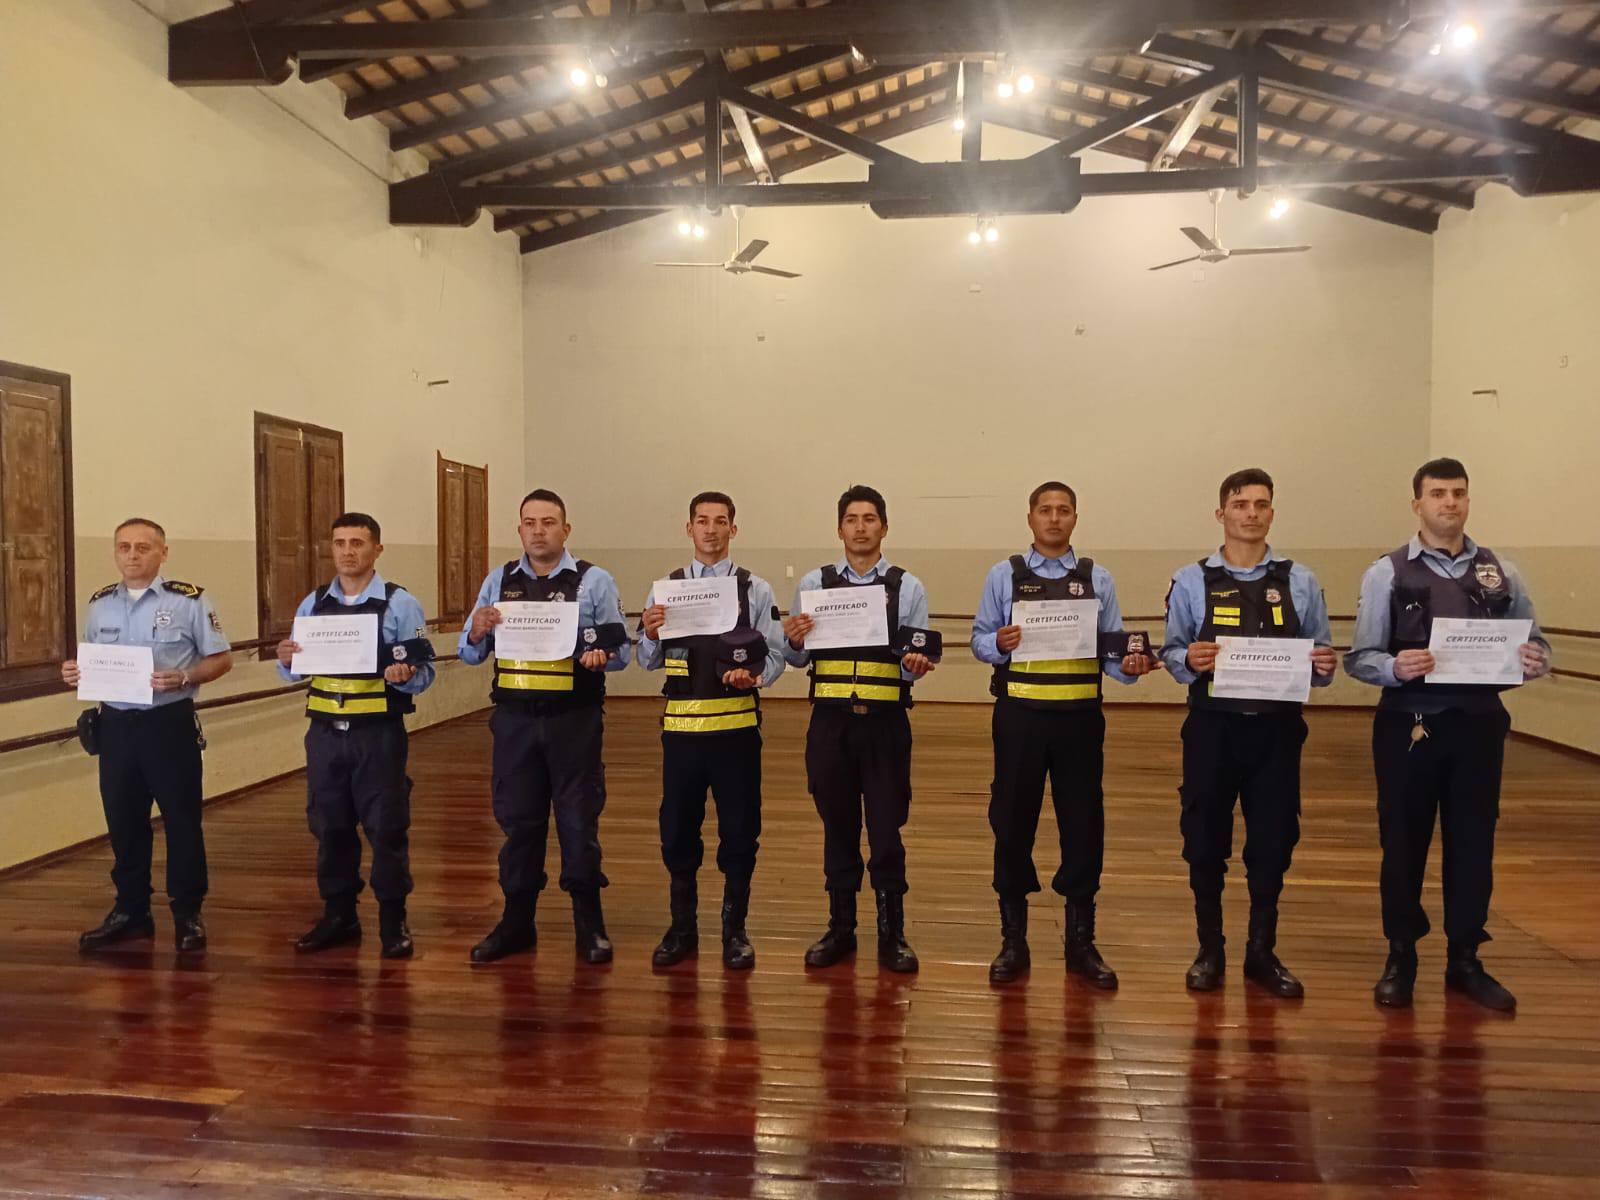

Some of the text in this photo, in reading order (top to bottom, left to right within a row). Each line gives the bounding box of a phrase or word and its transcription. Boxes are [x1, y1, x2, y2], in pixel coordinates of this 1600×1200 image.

[667, 592, 720, 602] CERTIFICADO
[814, 602, 868, 612] CERTIFICADO
[1025, 614, 1080, 624] CERTIFICADO
[306, 630, 360, 638] CERTIFICADO
[1446, 635, 1507, 643] CERTIFICADO
[1230, 653, 1291, 662] CERTIFICADO
